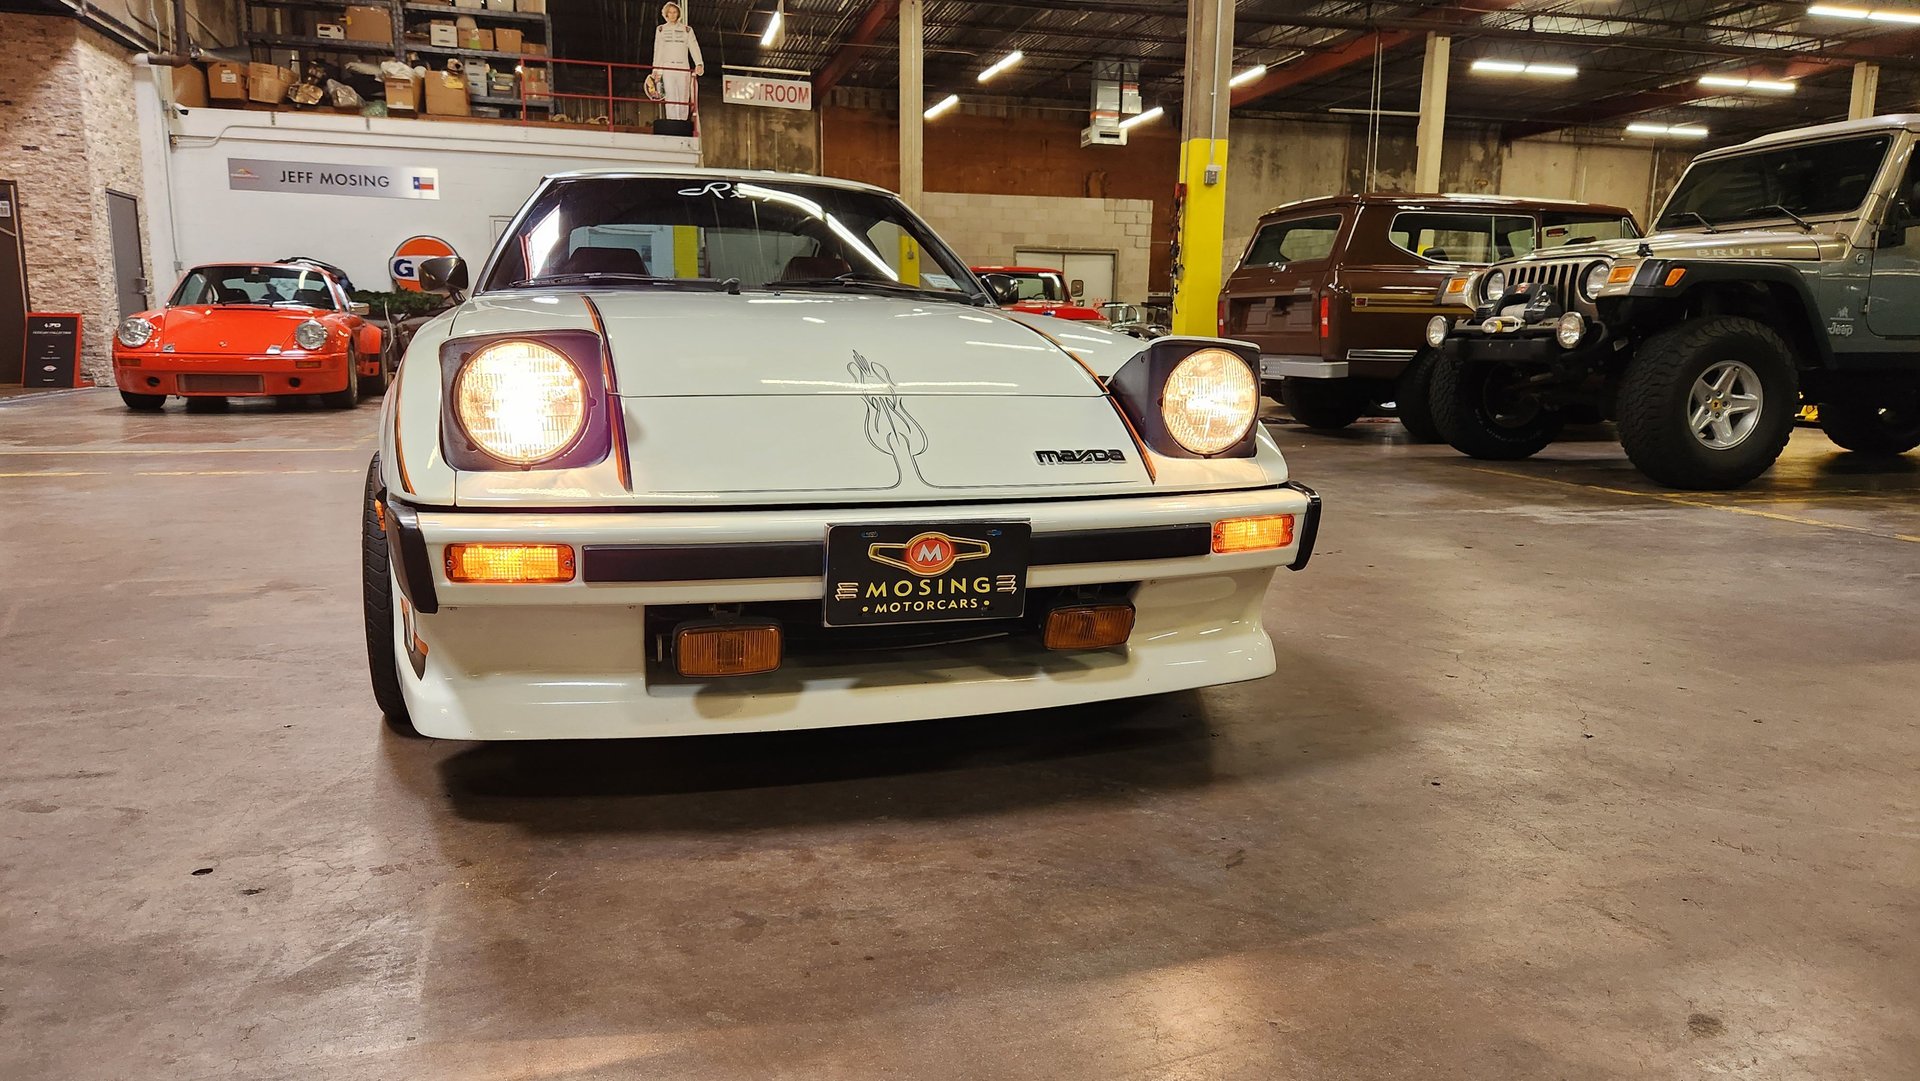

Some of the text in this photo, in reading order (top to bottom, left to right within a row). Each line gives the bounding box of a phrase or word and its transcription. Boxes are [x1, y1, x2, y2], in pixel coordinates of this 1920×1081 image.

[279, 170, 390, 188] JEFF MOSING
[1696, 248, 1773, 257] BRUTE
[1827, 321, 1853, 337] Jeep
[917, 543, 943, 562] M
[865, 576, 991, 599] MOSING
[874, 598, 978, 614] MOTORCARS
